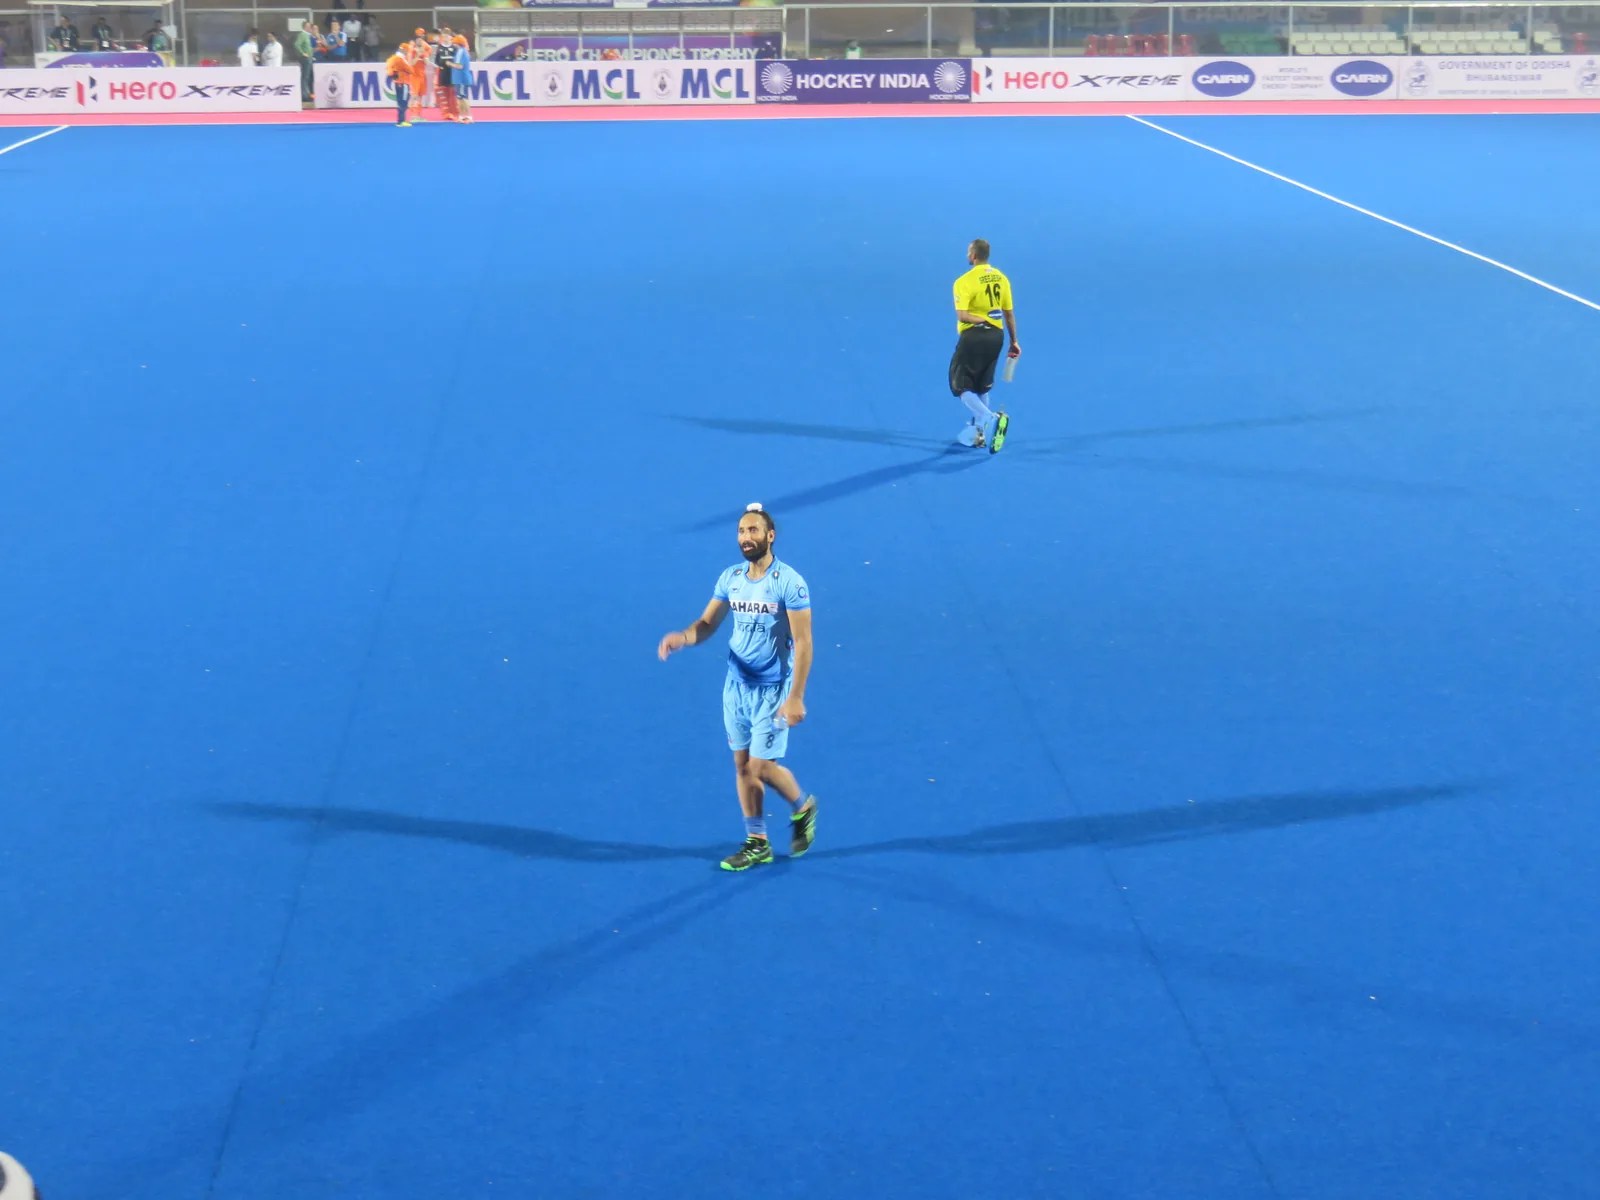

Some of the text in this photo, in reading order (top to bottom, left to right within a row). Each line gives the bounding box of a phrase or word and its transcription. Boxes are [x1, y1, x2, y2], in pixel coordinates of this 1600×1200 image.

[1438, 61, 1571, 70] GOVERNMENT OF ODISHA
[468, 70, 530, 100] MCL
[571, 69, 640, 99] MCL
[680, 68, 749, 98] MCL
[796, 73, 930, 89] HOCKEY INDIA
[1197, 74, 1250, 84] CAIRN
[1336, 74, 1388, 84] CAIRN
[180, 85, 295, 100] XTREME
[729, 601, 770, 614] AHARA
[765, 734, 775, 749] 8
